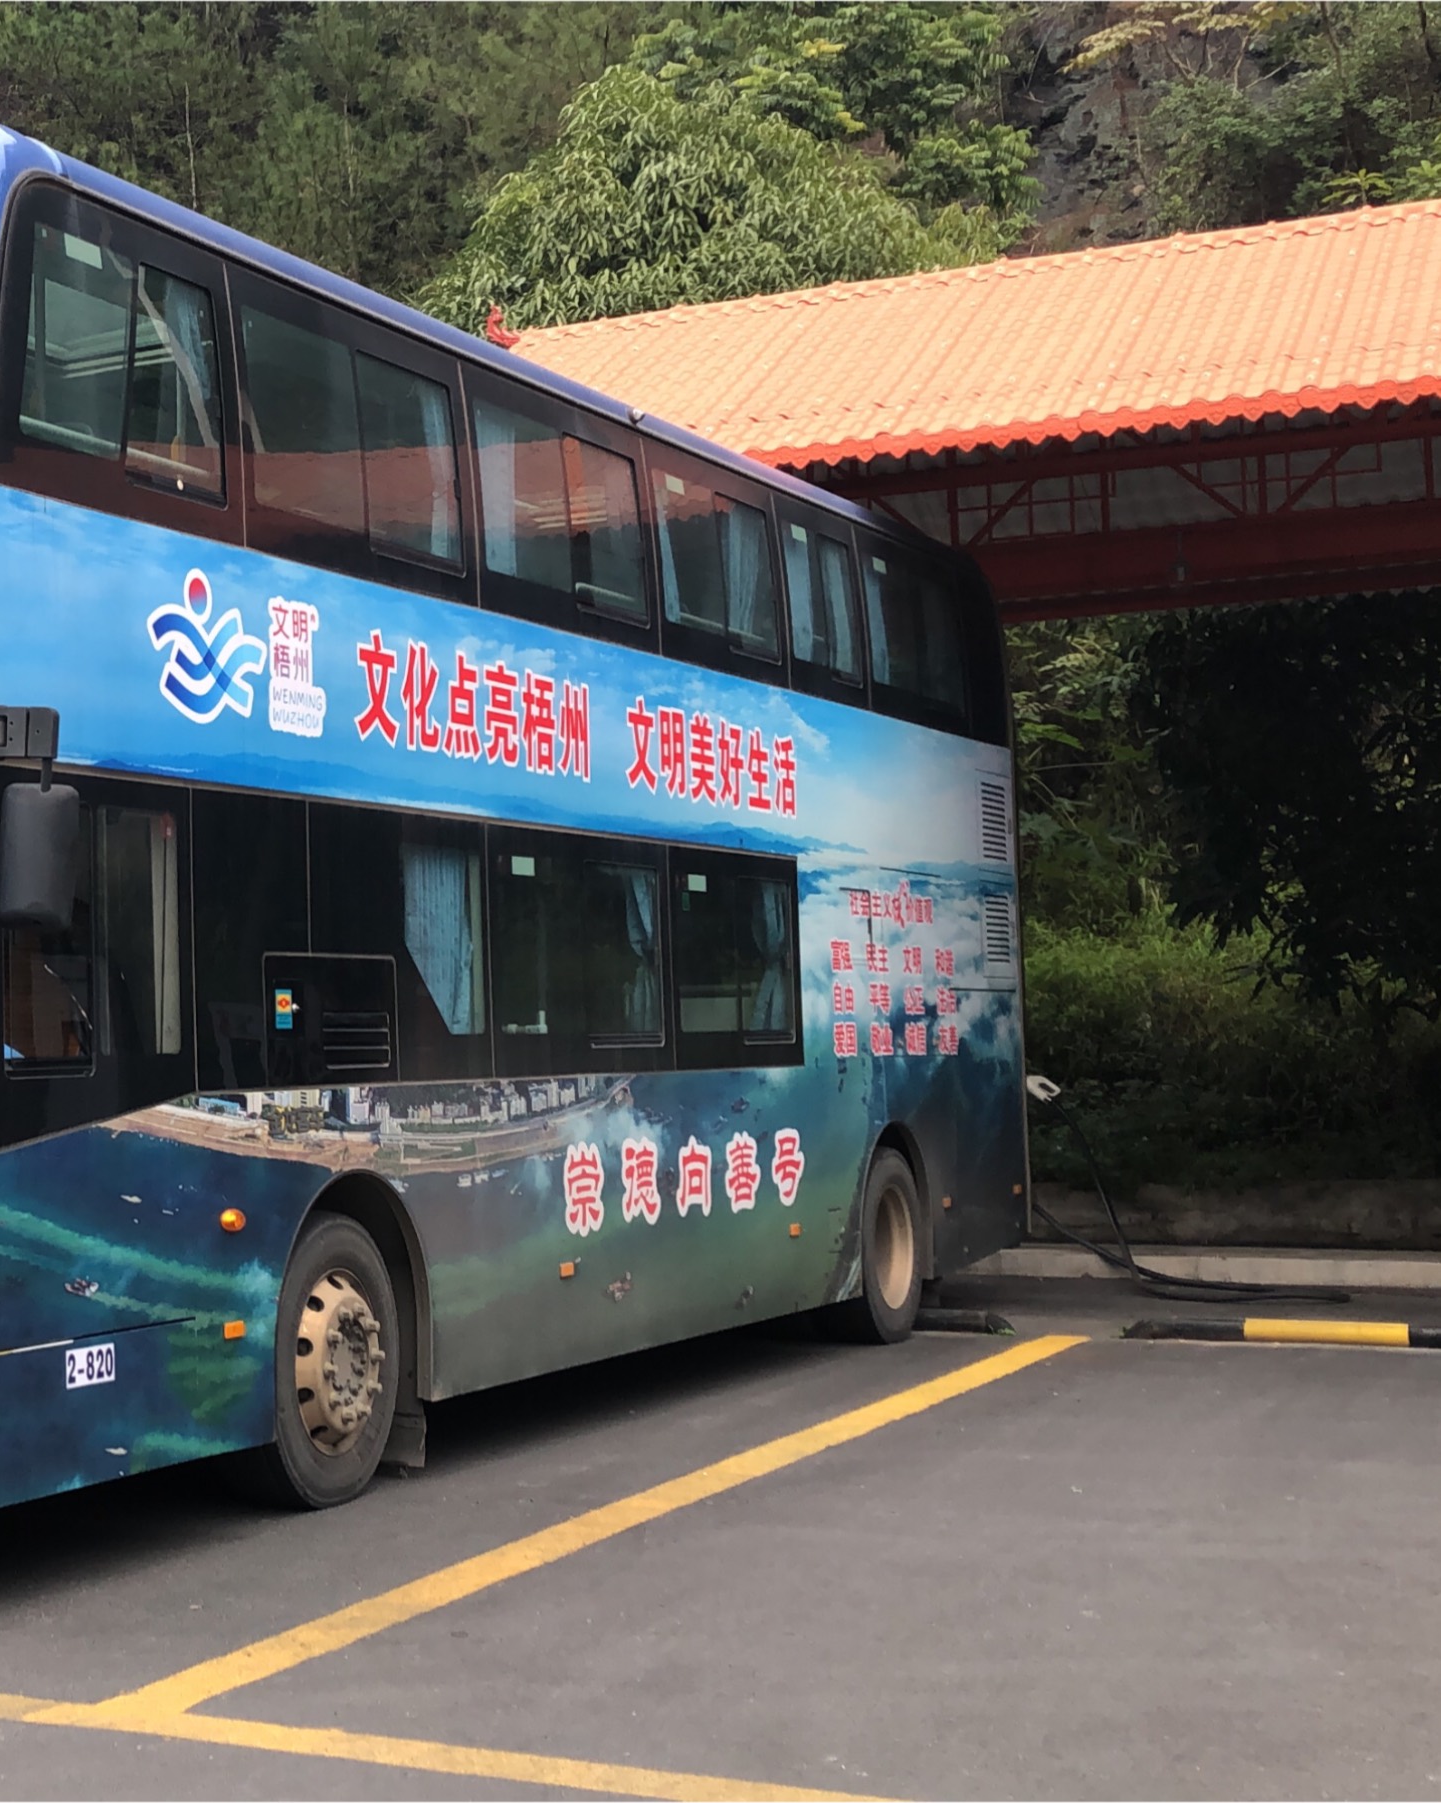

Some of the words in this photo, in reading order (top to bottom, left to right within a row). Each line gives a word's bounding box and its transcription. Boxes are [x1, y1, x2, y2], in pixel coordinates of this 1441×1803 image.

[271, 604, 309, 643] 文明
[272, 644, 310, 683] 梧州
[272, 686, 323, 712] WENMING
[272, 708, 320, 730] WUZHOU
[355, 630, 591, 782] 文化点亮梧州
[626, 697, 797, 817] 文明美好生活
[866, 943, 889, 973] 民主
[902, 945, 922, 974] 文明
[833, 982, 855, 1014] 自由
[564, 1129, 804, 1236] 崇德向善号
[67, 1346, 114, 1385] 2-820
